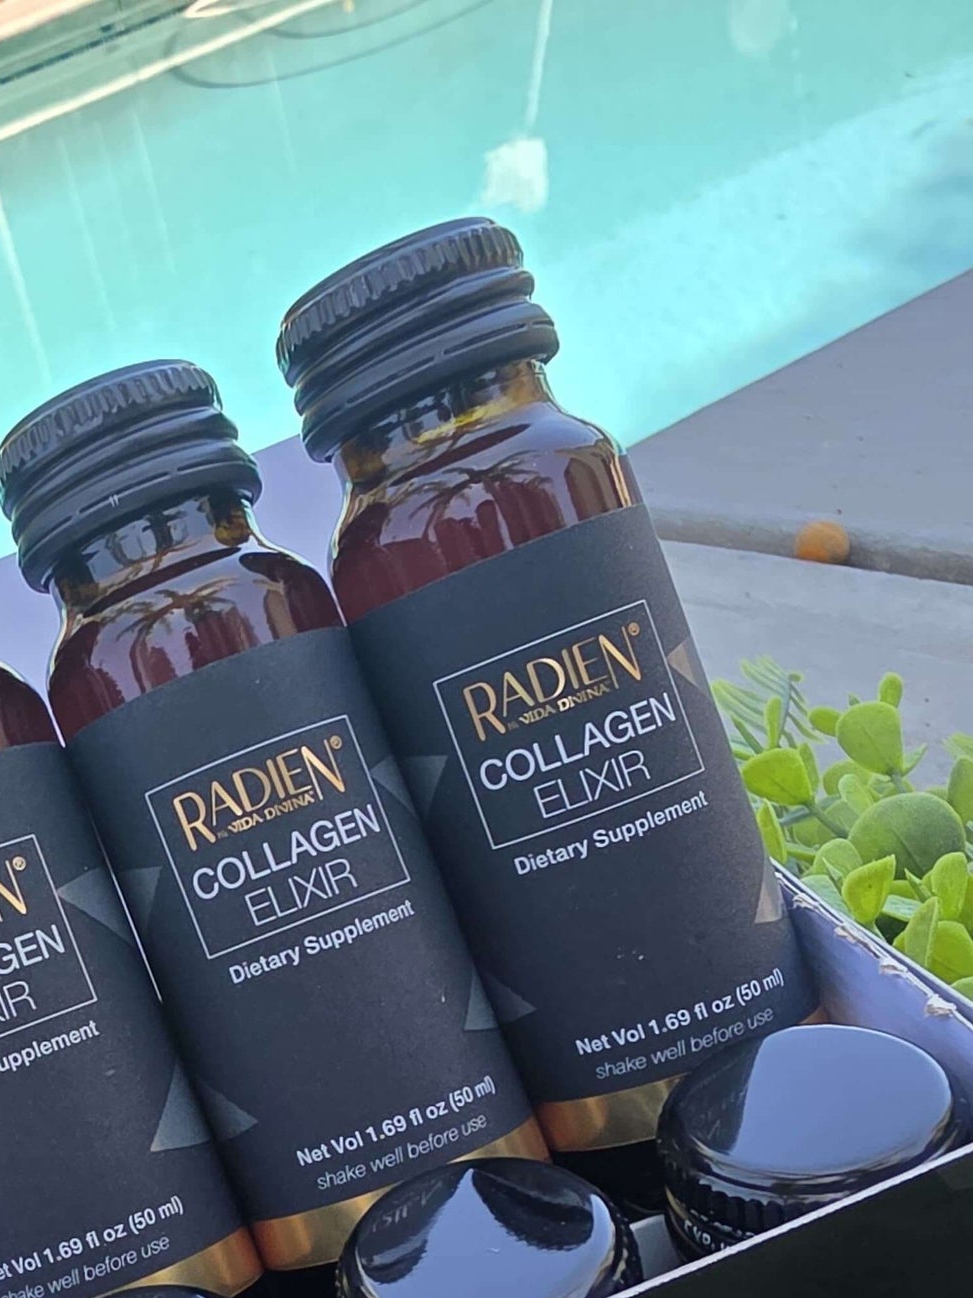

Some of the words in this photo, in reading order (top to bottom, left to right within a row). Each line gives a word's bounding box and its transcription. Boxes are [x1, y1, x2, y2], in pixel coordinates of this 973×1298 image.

[479, 693, 676, 791] COLLAGEN
[519, 705, 556, 724] VIDA
[533, 749, 651, 819] ELIXIR
[192, 804, 381, 900] COLLAGEN
[228, 813, 264, 834] VIDA
[514, 838, 589, 876] Dietary
[593, 790, 708, 848] Supplement
[245, 857, 358, 926] ELIXIR
[229, 948, 301, 985] Dietary
[304, 899, 415, 957] Supplement
[575, 1035, 611, 1055] Net
[611, 1024, 645, 1046] Vol
[648, 1009, 691, 1035] 1.69
[694, 1002, 708, 1020] fl
[712, 995, 735, 1013] oz
[736, 980, 761, 1006] (50
[763, 968, 784, 991] ml)
[595, 1056, 647, 1079] shake
[651, 1040, 686, 1065] well
[690, 1020, 744, 1052] before
[747, 1007, 773, 1029] use
[296, 1144, 331, 1166] Net
[330, 1131, 363, 1154] Vol
[365, 1115, 407, 1142] 1.69
[409, 1108, 423, 1126] fl
[426, 1101, 449, 1119] oz
[449, 1086, 473, 1112] (50
[474, 1075, 496, 1098] ml)
[317, 1163, 366, 1190] shake
[370, 1147, 404, 1173] well
[407, 1127, 459, 1159] before
[461, 1114, 487, 1136] use
[11, 1253, 42, 1274] Vol
[43, 1238, 83, 1264] 1.69
[86, 1231, 100, 1249] fl
[103, 1224, 127, 1242] oz
[128, 1208, 155, 1234] (50
[158, 1195, 184, 1219] ml)
[47, 1268, 80, 1294] well
[84, 1250, 137, 1281] before
[141, 1236, 170, 1258] use
